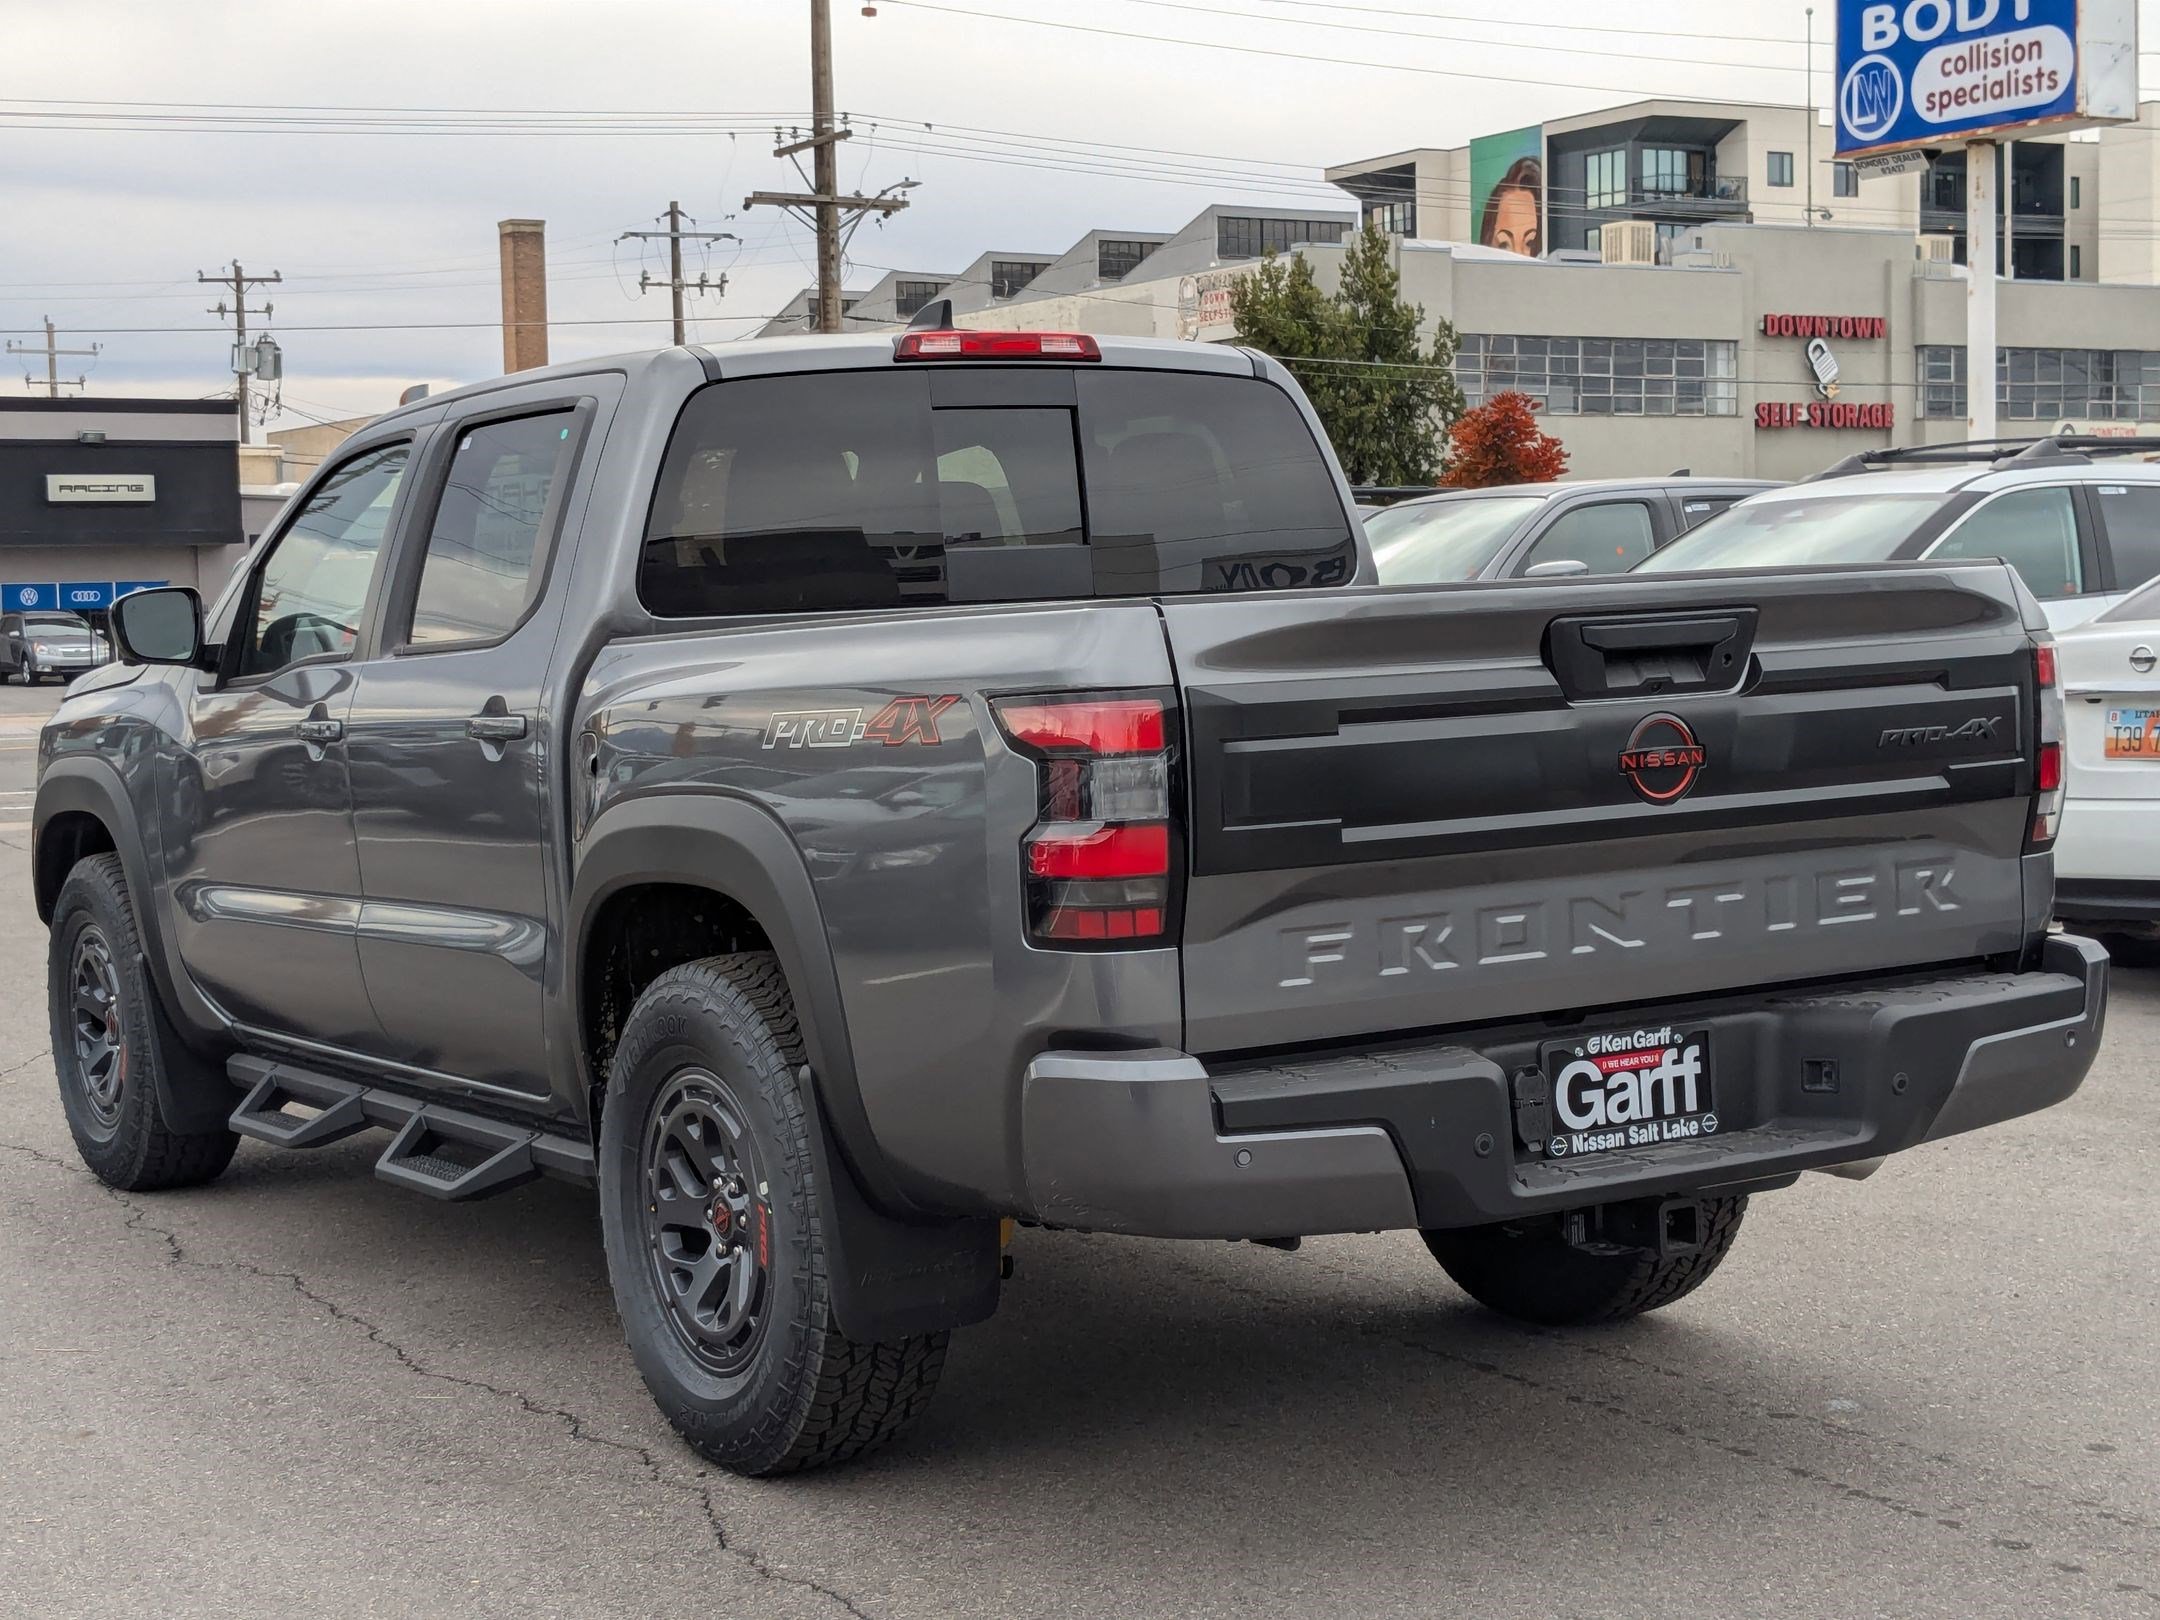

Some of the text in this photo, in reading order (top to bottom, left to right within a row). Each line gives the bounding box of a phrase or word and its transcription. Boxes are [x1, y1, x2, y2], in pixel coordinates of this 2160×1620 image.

[1940, 39, 2042, 78] collision
[1925, 67, 2058, 117] specialists
[1764, 314, 1888, 338] DOWNTOWN
[1756, 402, 1894, 428] SELF STORAGE
[59, 484, 144, 493] RACING
[1621, 750, 1704, 769] NISSAN
[1279, 857, 1960, 986] FRONTIER
[1601, 1026, 1672, 1053] Ken Garff
[1607, 1055, 1654, 1069] WE HEAR YOU
[1555, 1045, 1702, 1130] Garff
[1571, 1118, 1699, 1154] Nissan Salt Lake
